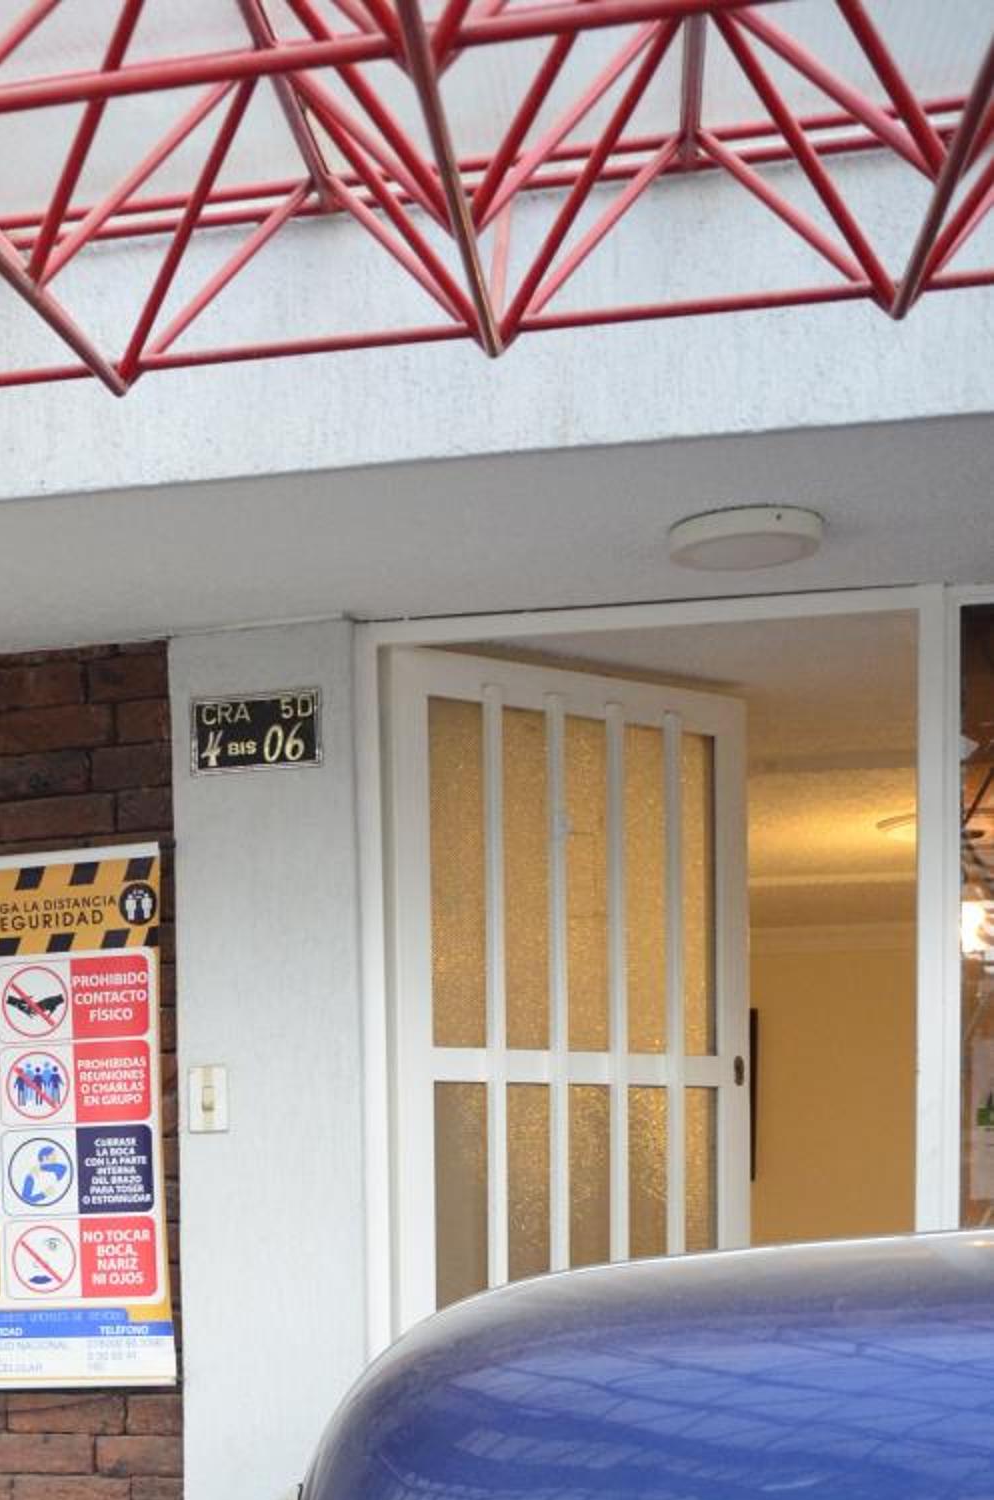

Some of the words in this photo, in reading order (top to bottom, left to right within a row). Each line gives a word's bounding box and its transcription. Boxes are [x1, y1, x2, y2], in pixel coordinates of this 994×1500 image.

[201, 703, 251, 725] CRA
[280, 694, 314, 719] 5D
[201, 730, 223, 767] 4
[227, 740, 257, 756] BIS
[263, 722, 305, 762] 06
[23, 900, 40, 913] LA
[43, 895, 117, 912] DISTANCIA
[72, 971, 147, 988] PROHIBIDO
[75, 989, 147, 1005] CONTACTO
[77, 1056, 147, 1070] PROHIBIDAS
[79, 1069, 145, 1083] REUNIONES
[81, 1083, 90, 1094] O
[92, 1081, 145, 1093] CHARLAS
[83, 1095, 101, 1106] EN
[102, 1093, 142, 1105] GRUPO
[95, 1148, 108, 1157] LA
[110, 1147, 136, 1156] BOCA
[85, 1157, 104, 1167] CON
[106, 1157, 118, 1166] LA
[119, 1155, 147, 1165] PARTE
[91, 1175, 109, 1185] DEL
[111, 1175, 143, 1185] BRAZO
[89, 1185, 115, 1195] PARA
[82, 1195, 91, 1205] O
[83, 1231, 103, 1243] NO
[107, 1229, 150, 1242] TOCAR
[97, 1257, 138, 1270] NARIZ
[93, 1273, 107, 1284] NI
[109, 1271, 144, 1285] OJOS
